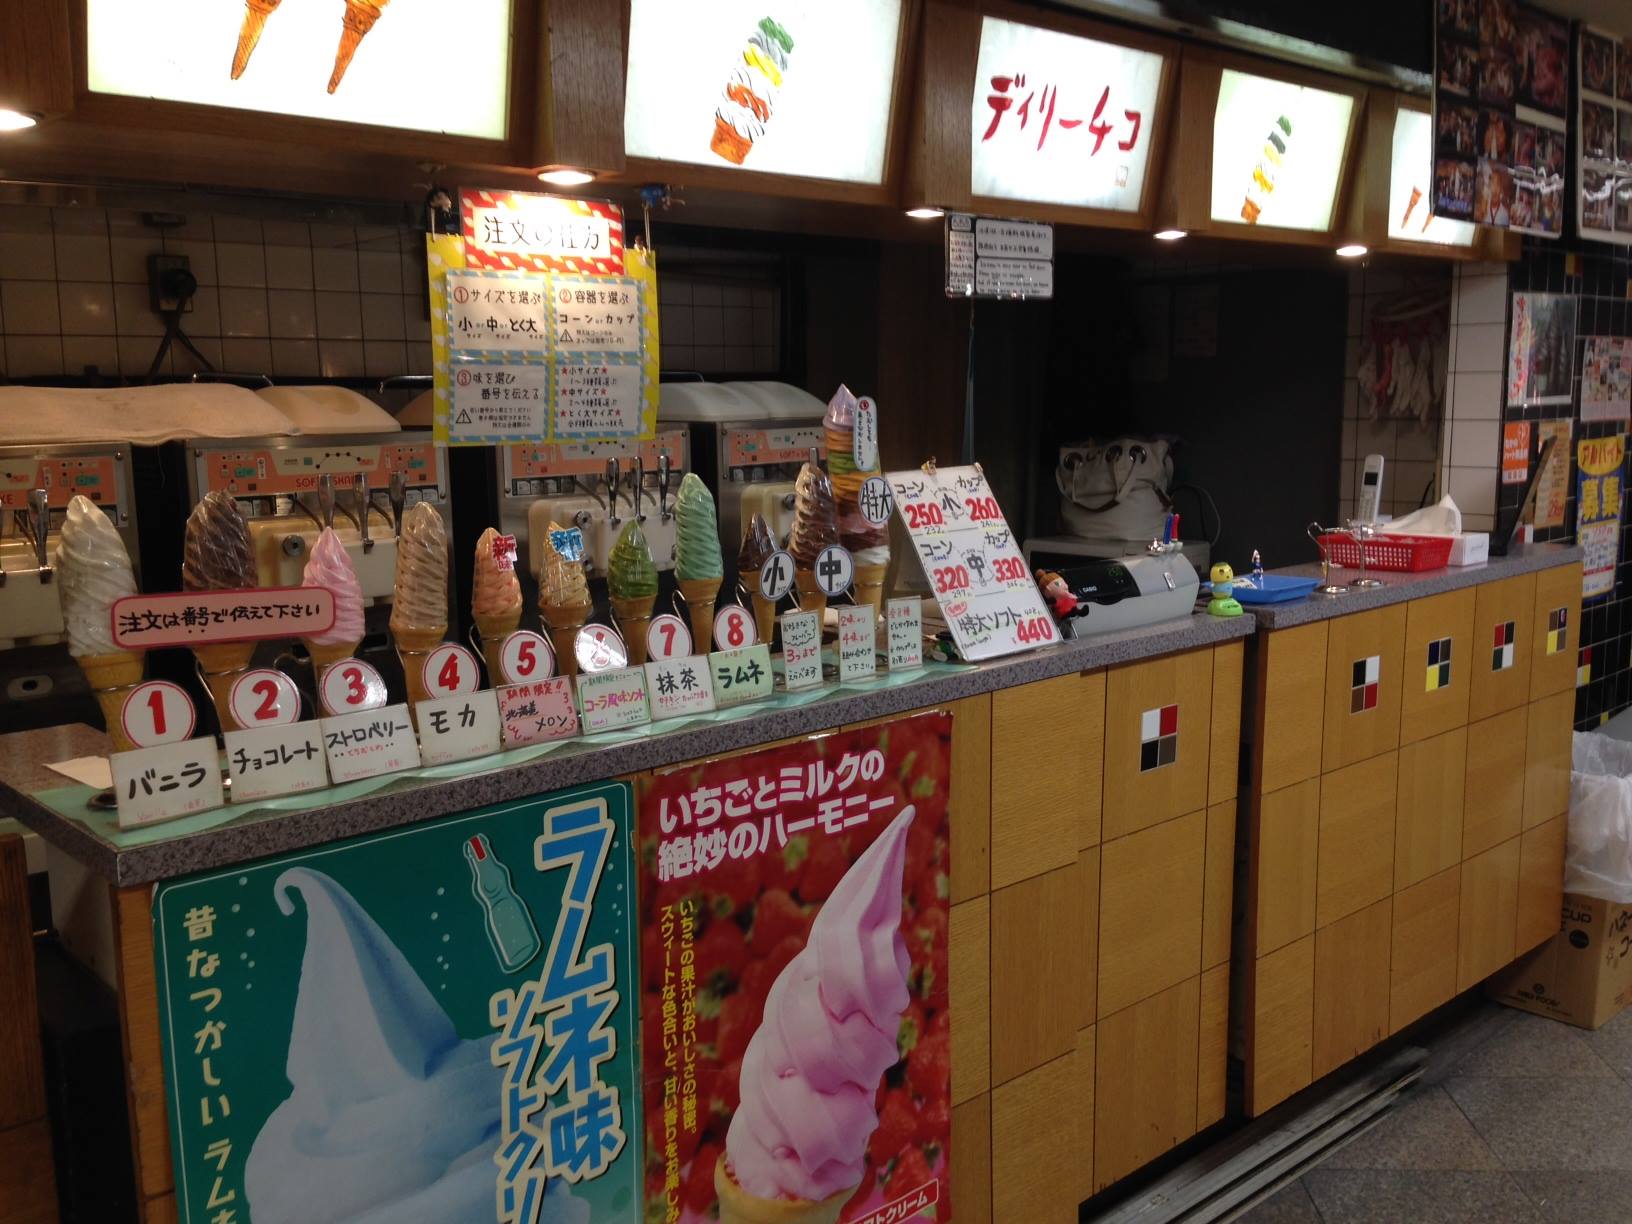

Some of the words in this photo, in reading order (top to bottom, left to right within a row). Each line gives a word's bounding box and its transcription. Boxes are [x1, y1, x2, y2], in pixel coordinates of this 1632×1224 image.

[484, 215, 600, 250] 注文の仕方
[894, 480, 925, 495] コーン
[956, 474, 984, 489] カップ
[904, 502, 943, 529] 250
[942, 493, 962, 513] 小
[964, 497, 999, 521] 260
[920, 539, 953, 557] コーン
[984, 528, 1010, 545] カップ
[763, 556, 785, 595] 小
[820, 551, 841, 591] 中
[933, 565, 970, 594] 320
[966, 553, 986, 579] 中
[992, 556, 1026, 583] 330
[119, 603, 321, 637] 注文は番号で伝えて下さい
[727, 613, 744, 646] 8
[958, 605, 1022, 636] 特大ソフト
[1017, 616, 1054, 644] 440
[659, 623, 676, 656] 7
[438, 652, 460, 691] 4
[517, 640, 536, 677] 5
[718, 659, 765, 689] ラムネ
[252, 679, 280, 720] 2
[341, 667, 367, 705] 3
[656, 668, 699, 696] 抹茶
[147, 690, 167, 735] 1
[430, 704, 476, 735] モカ
[536, 714, 568, 732] メロン
[325, 720, 409, 750] ストロベリー
[233, 740, 319, 775] チョコレート
[128, 762, 207, 800] バニラ
[659, 748, 885, 835] いちごとミルクの
[658, 794, 895, 883] 絶妙のハーモニー
[534, 796, 627, 1182] ラムネ味
[679, 900, 698, 1135] いちごの果汁がおいしさの秘密。
